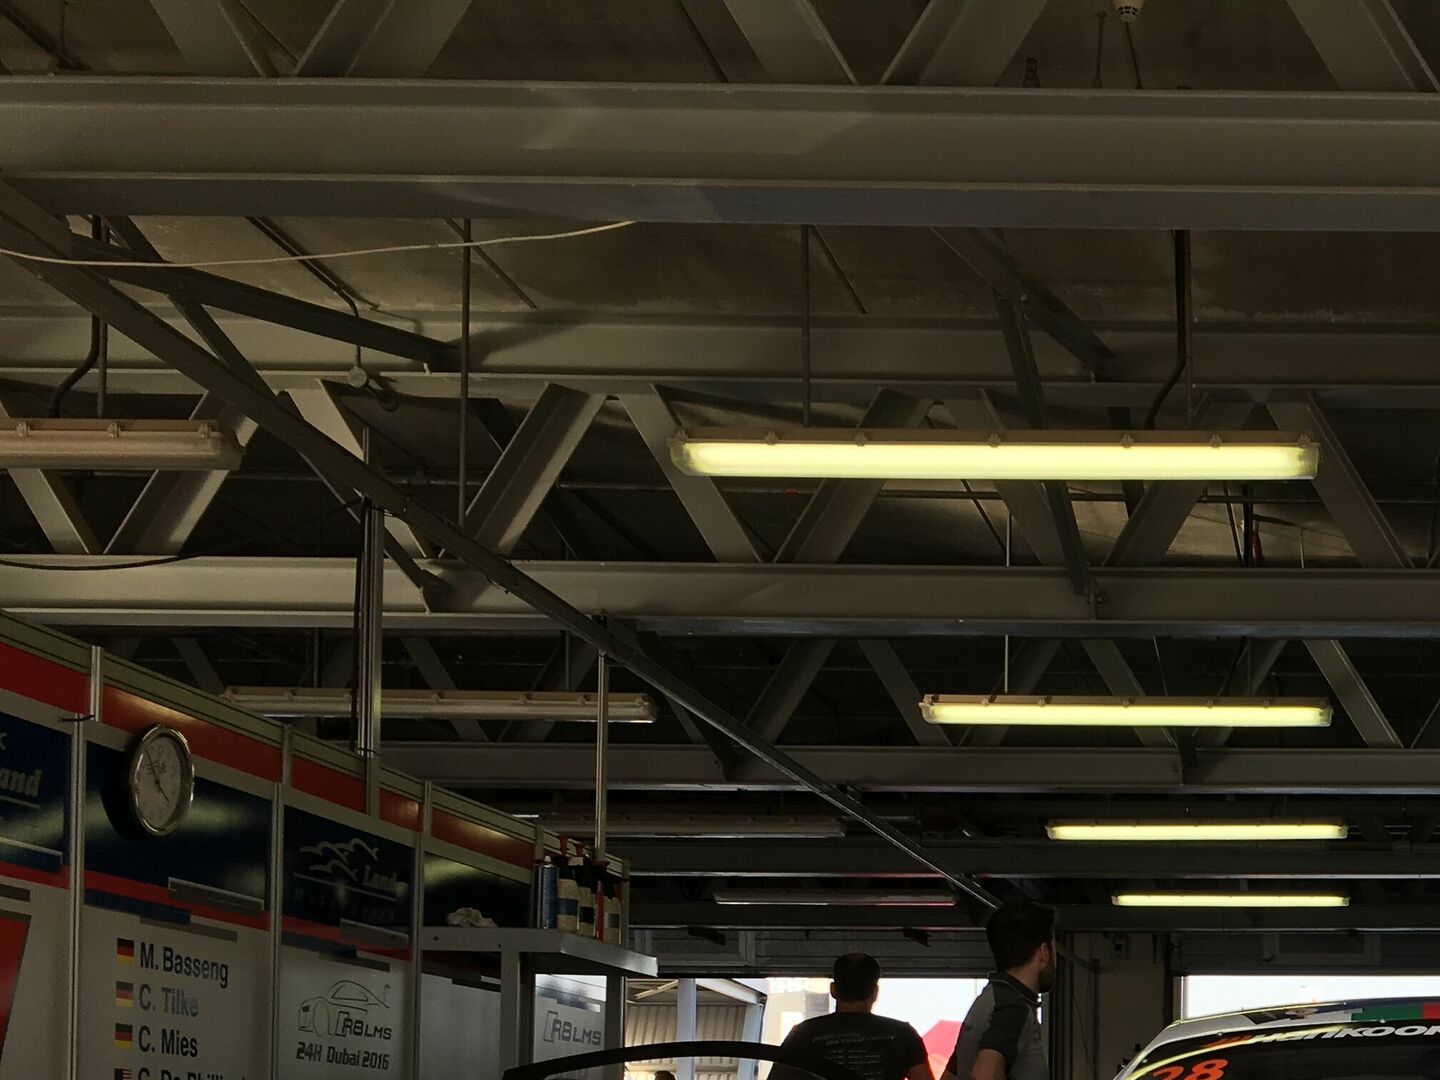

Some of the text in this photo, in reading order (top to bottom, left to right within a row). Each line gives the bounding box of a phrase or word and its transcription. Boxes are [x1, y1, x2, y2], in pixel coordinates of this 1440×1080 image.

[140, 942, 229, 988] M. Basseng
[139, 983, 199, 1017] C. Tilke
[138, 1025, 198, 1057] C. Mies
[296, 1041, 322, 1062] 24H
[326, 1046, 360, 1067] Dubai
